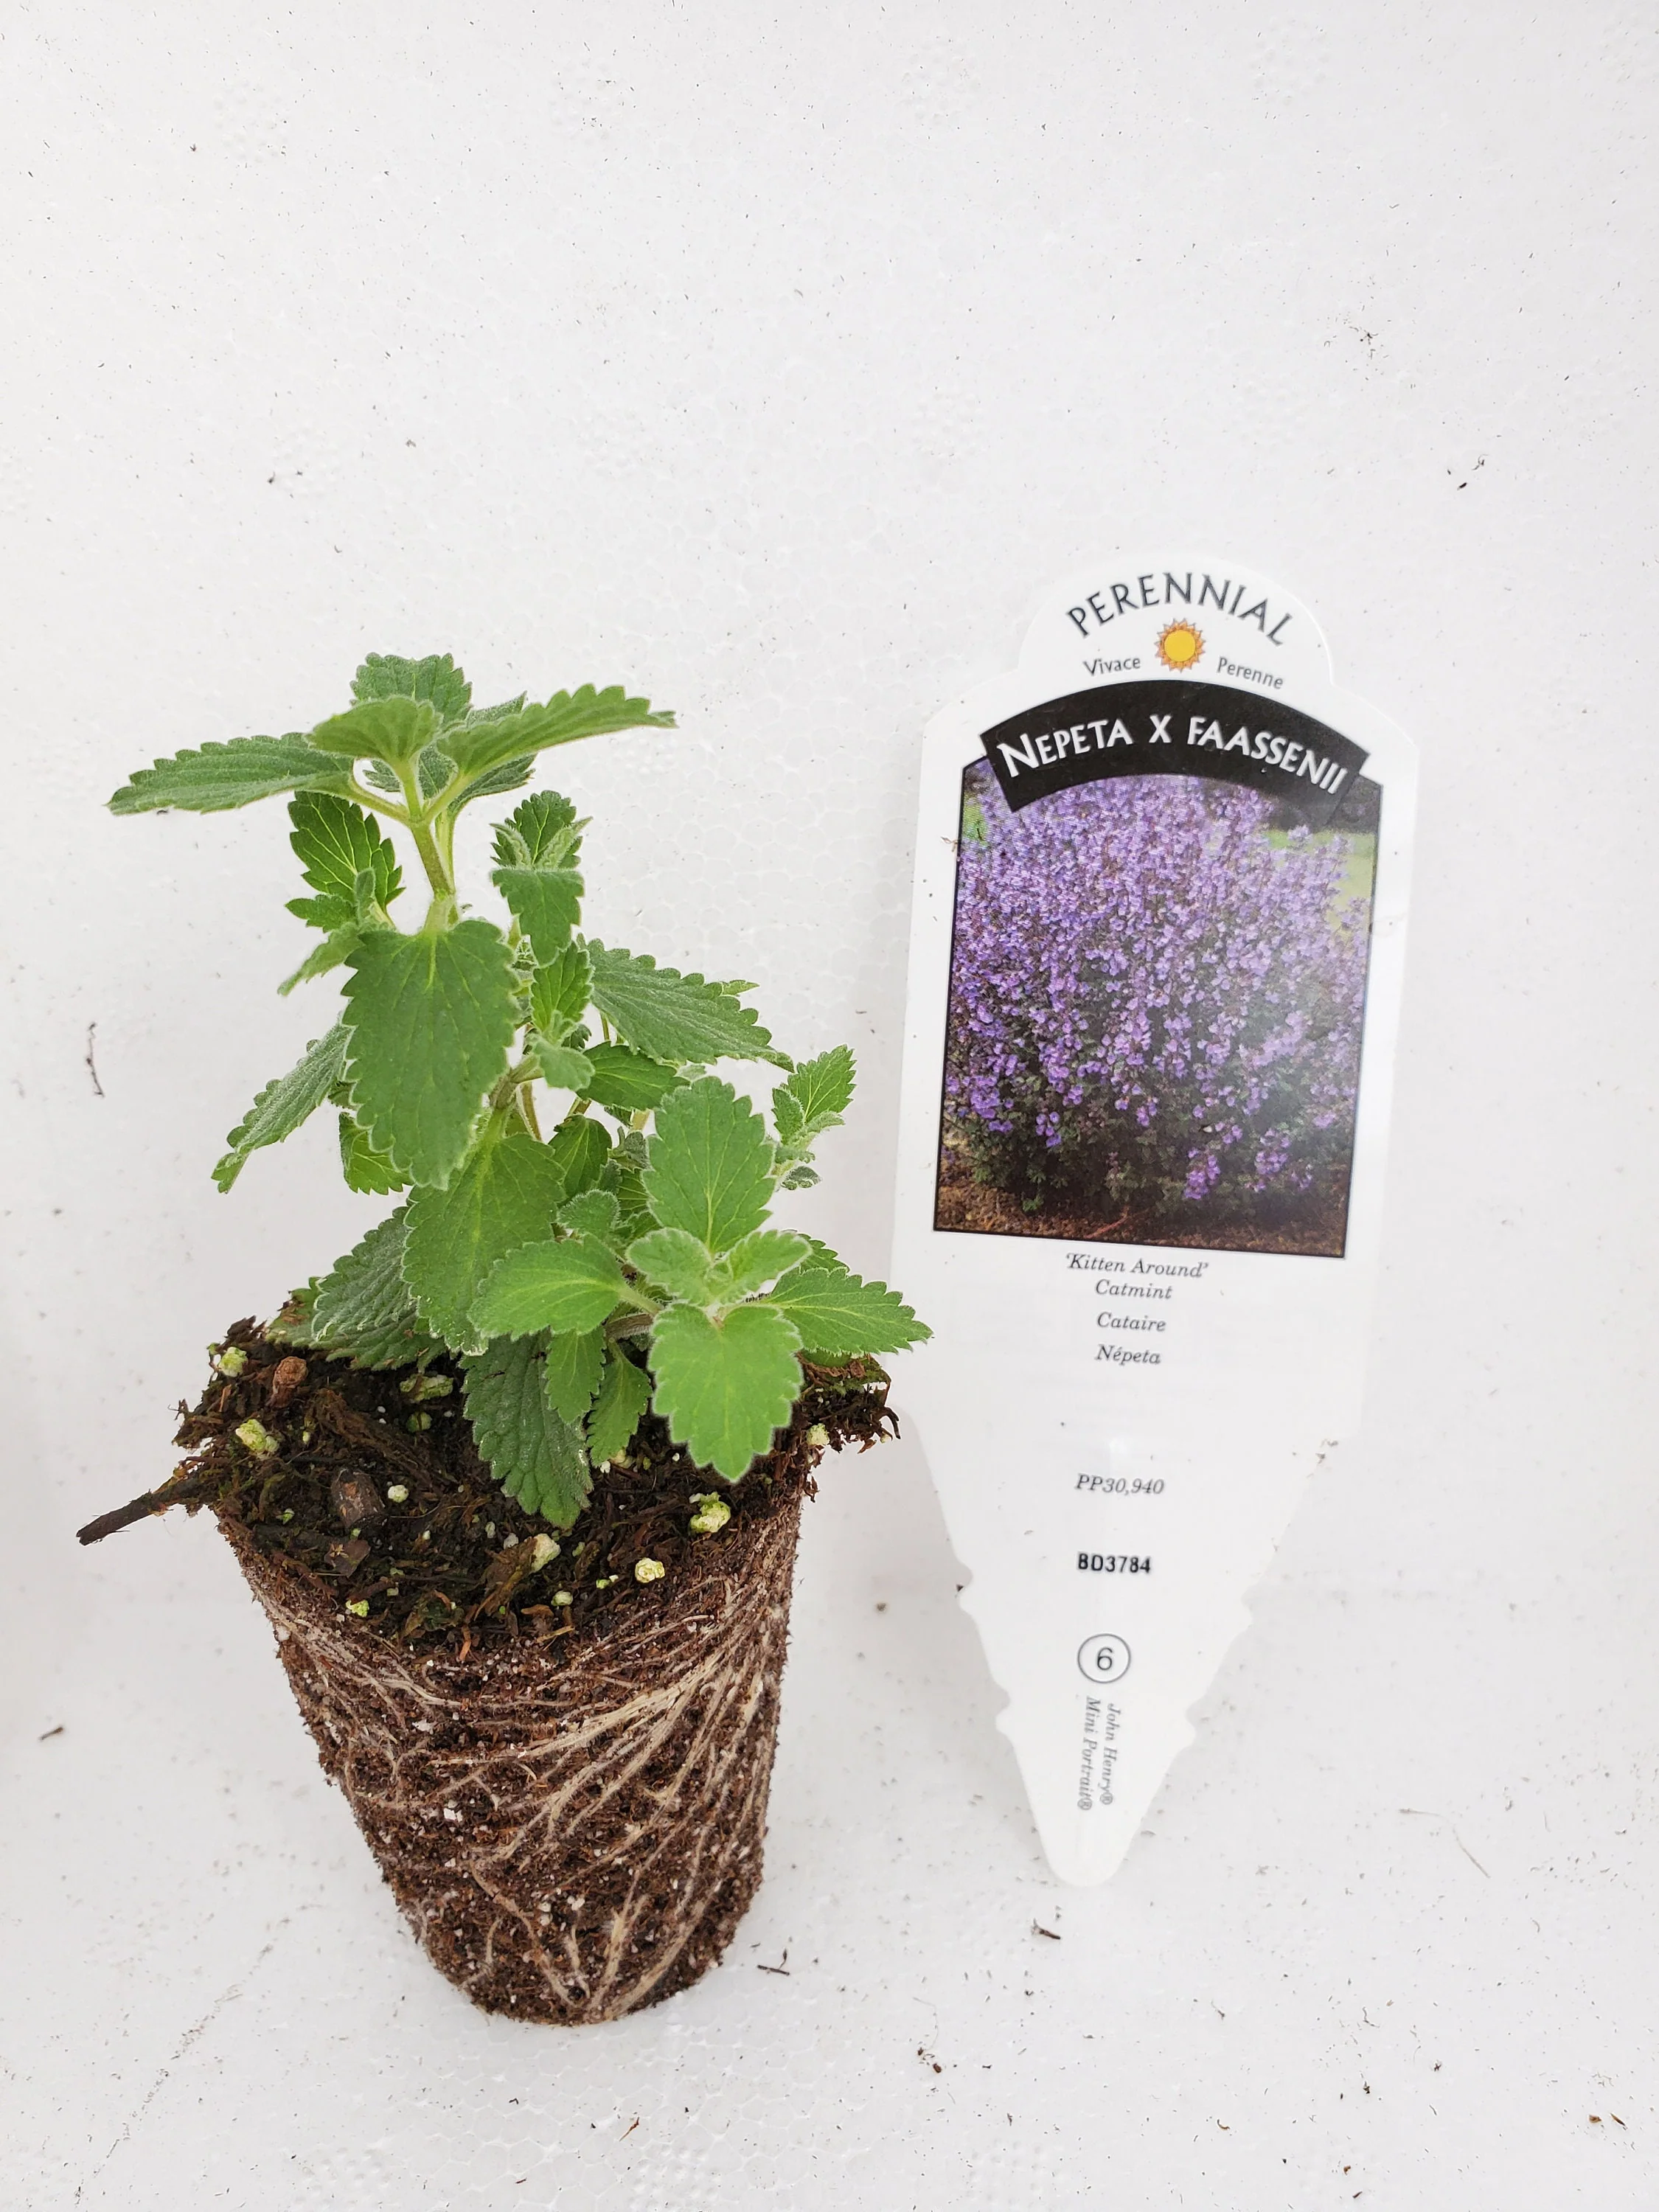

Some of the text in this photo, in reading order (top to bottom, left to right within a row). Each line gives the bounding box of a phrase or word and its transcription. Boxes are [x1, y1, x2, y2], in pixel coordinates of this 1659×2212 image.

[1065, 572, 1293, 647] PERENNIAL
[1082, 656, 1283, 689] Vivace Perenne
[996, 715, 1349, 795] NEPETA X FAASSENII
[1096, 1279, 1172, 1299] Catmint
[1097, 1312, 1166, 1332] Cataire
[1095, 1344, 1161, 1366] Népeta
[1076, 1473, 1164, 1495] PP30,940
[1077, 1552, 1152, 1574] BD3784
[1096, 1647, 1113, 1671] 6
[1085, 1696, 1101, 1733] Mini
[1106, 1703, 1121, 1740] John
